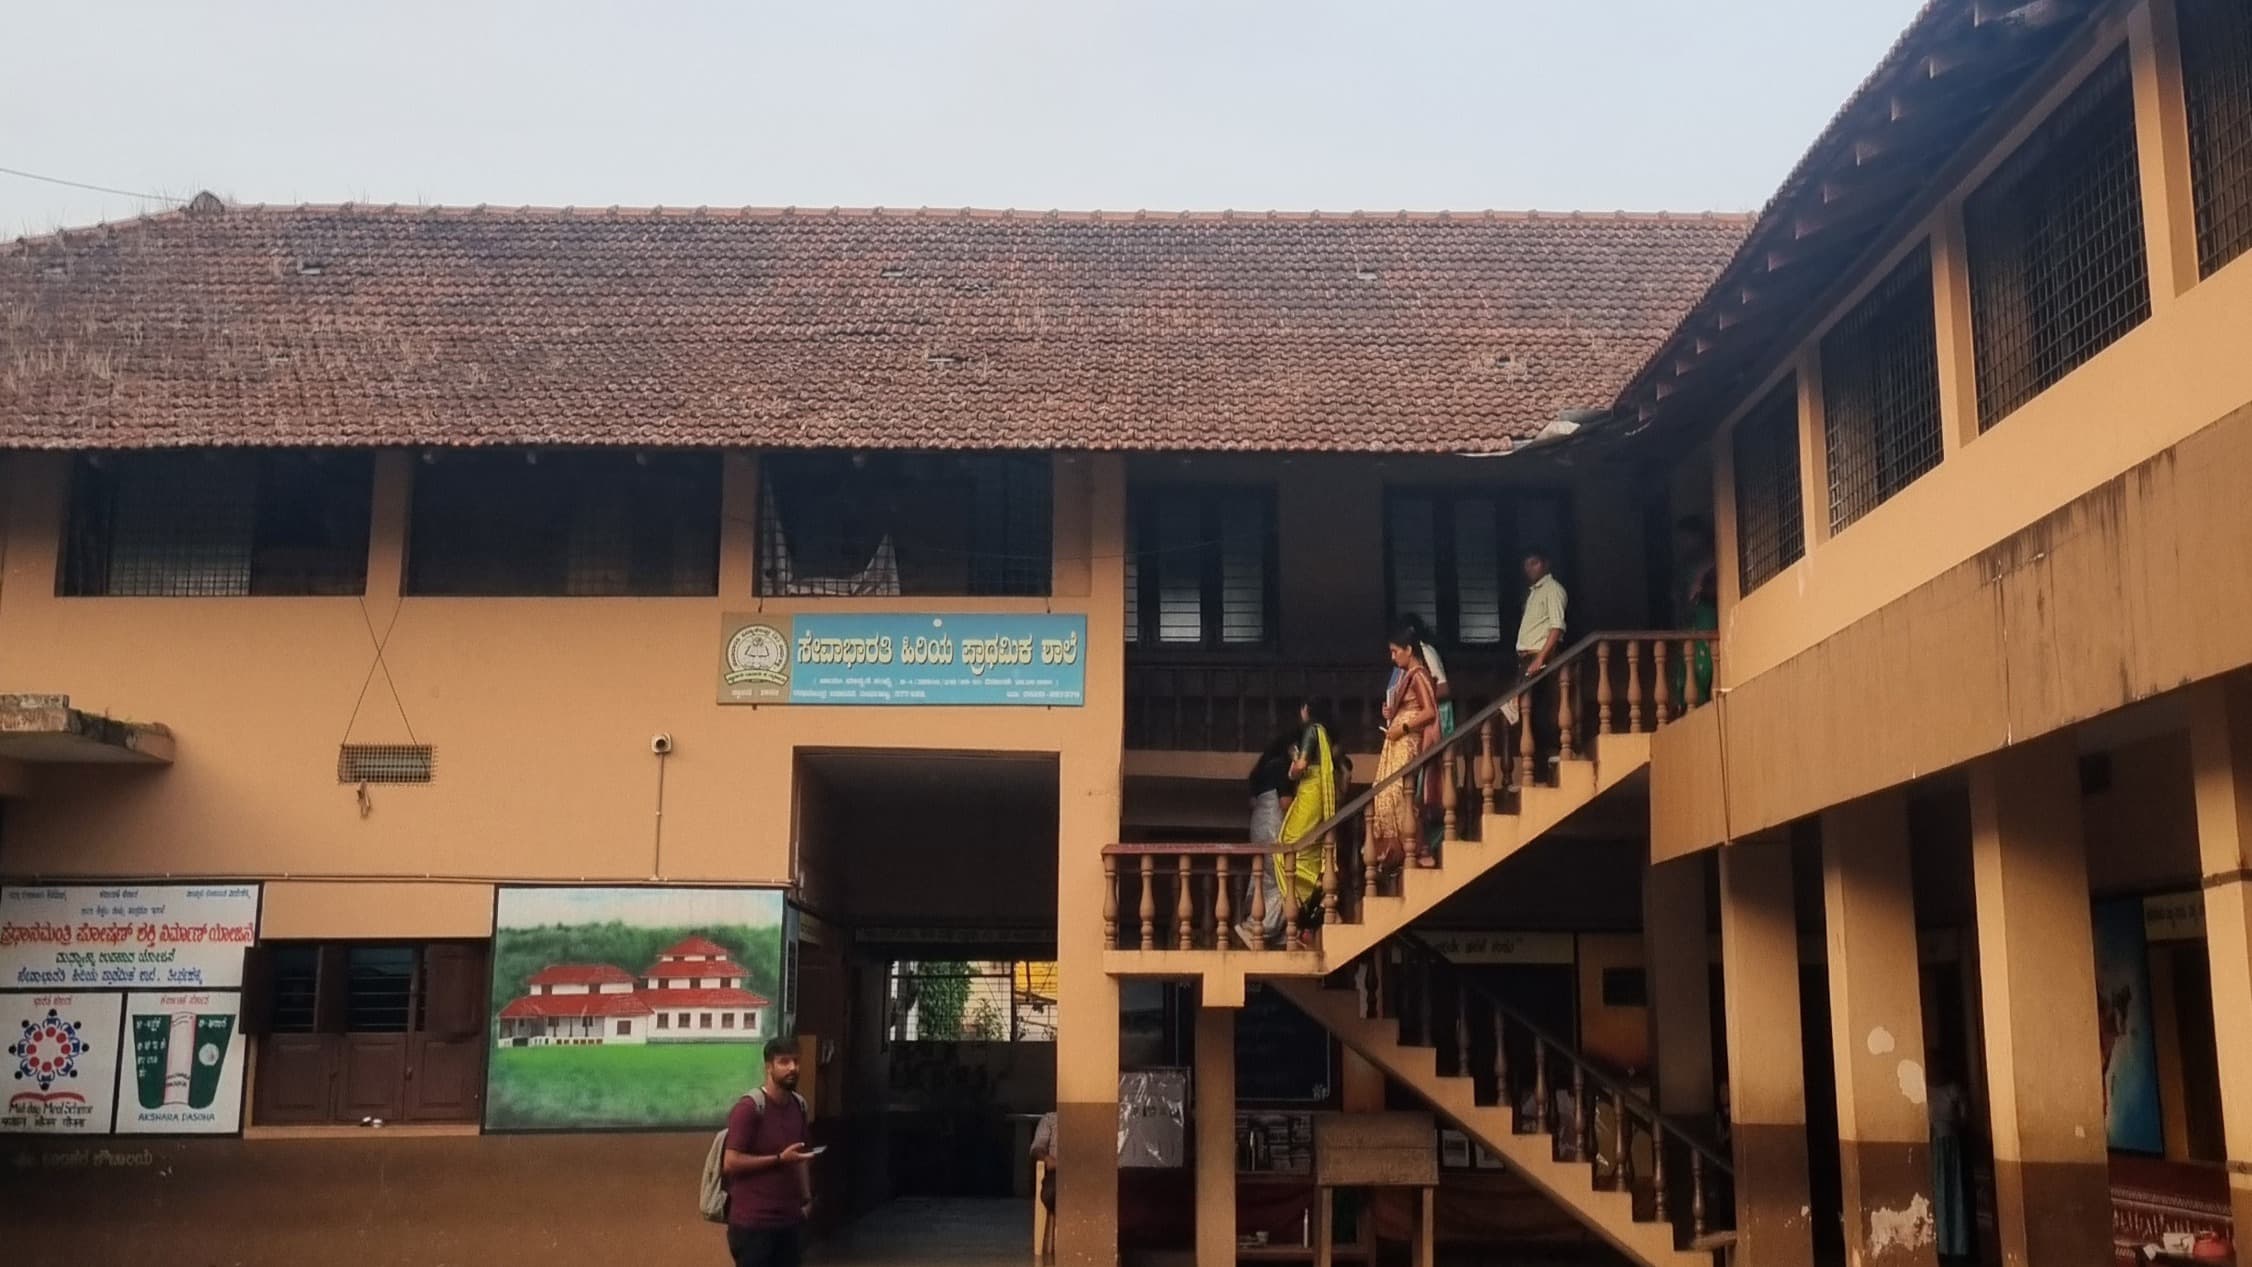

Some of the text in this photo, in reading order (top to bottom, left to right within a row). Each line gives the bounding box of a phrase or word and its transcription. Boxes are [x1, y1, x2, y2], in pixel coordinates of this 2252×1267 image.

[797, 630, 893, 668] ಸೇವಾಭಾರತಿ
[901, 635, 953, 665] ಹಿರಿಯ
[962, 632, 1033, 676] ಪ್ರಾಥಮಿಕ
[1041, 630, 1079, 666] ಶಾಲೆ
